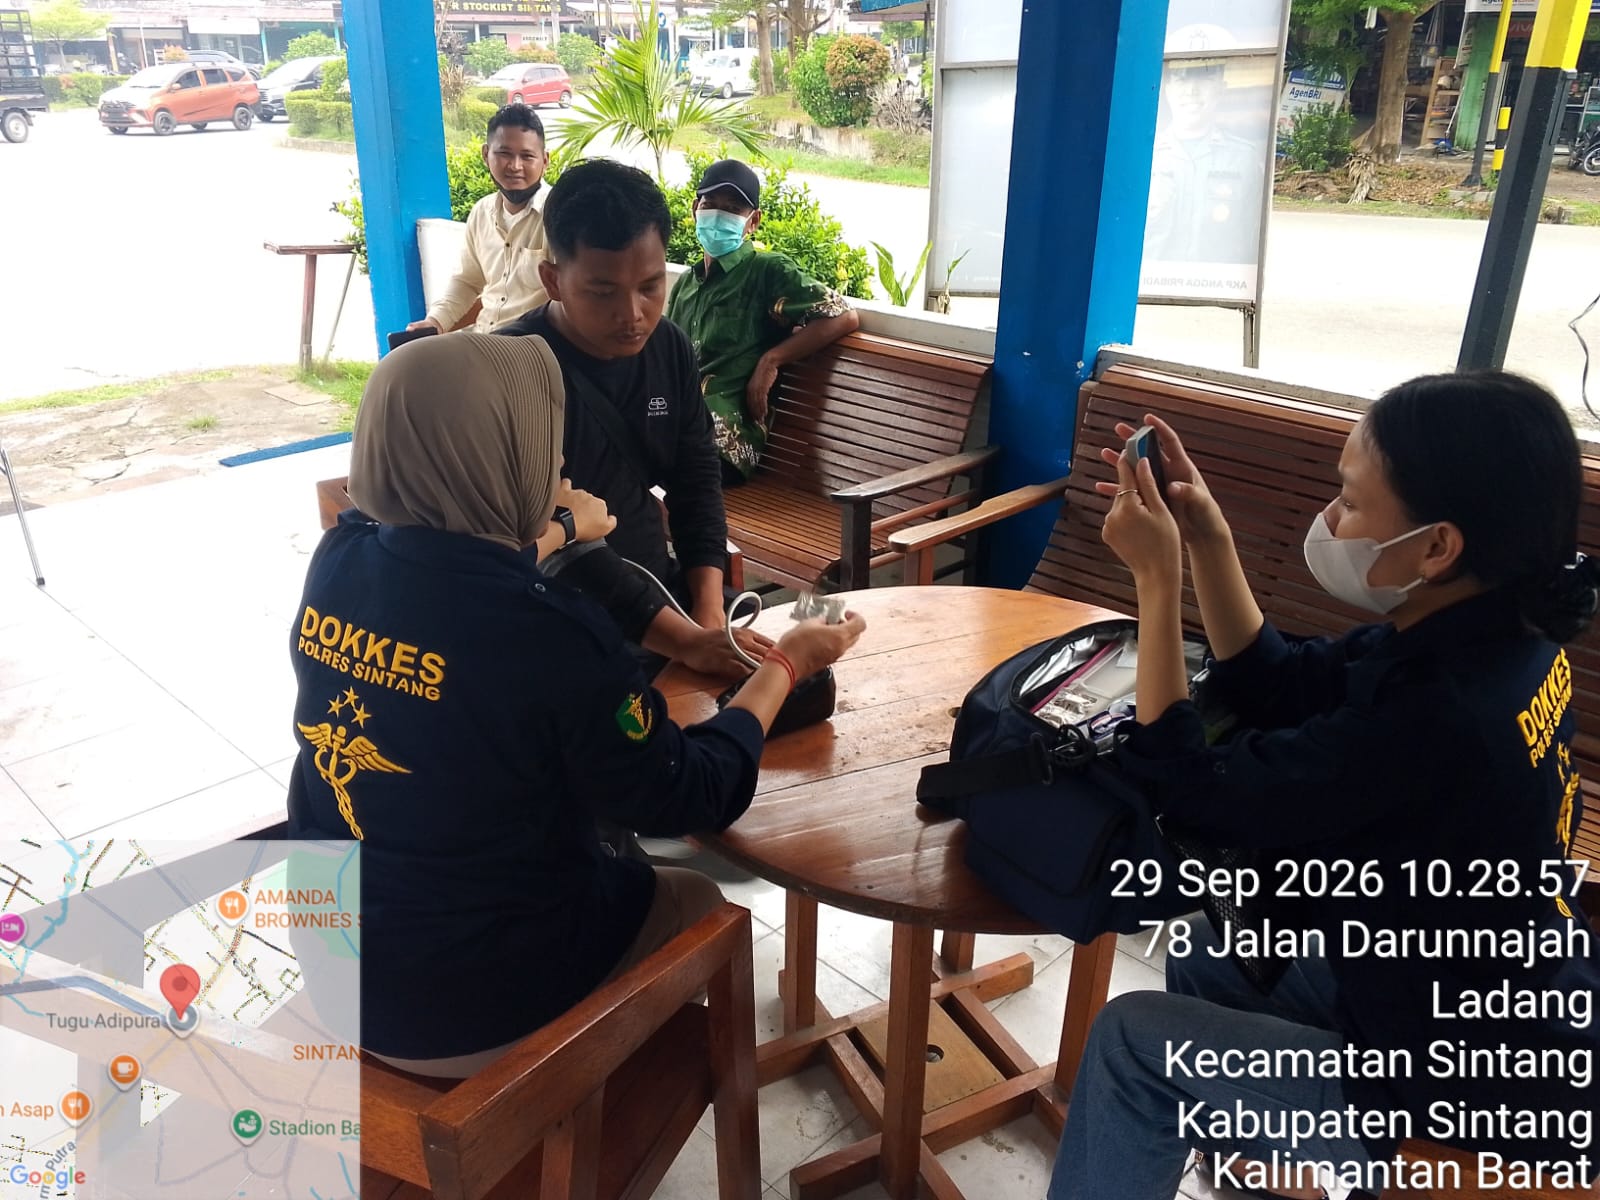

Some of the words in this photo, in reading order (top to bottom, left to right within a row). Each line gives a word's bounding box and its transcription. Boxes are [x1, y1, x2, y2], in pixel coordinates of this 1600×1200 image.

[463, 2, 513, 12] STOCKIST
[1289, 86, 1322, 100] AgenBRI
[298, 635, 351, 673] POLRES
[351, 662, 441, 701] SINTANG
[300, 605, 447, 686] DOKKES
[1515, 647, 1572, 748] DOKKES
